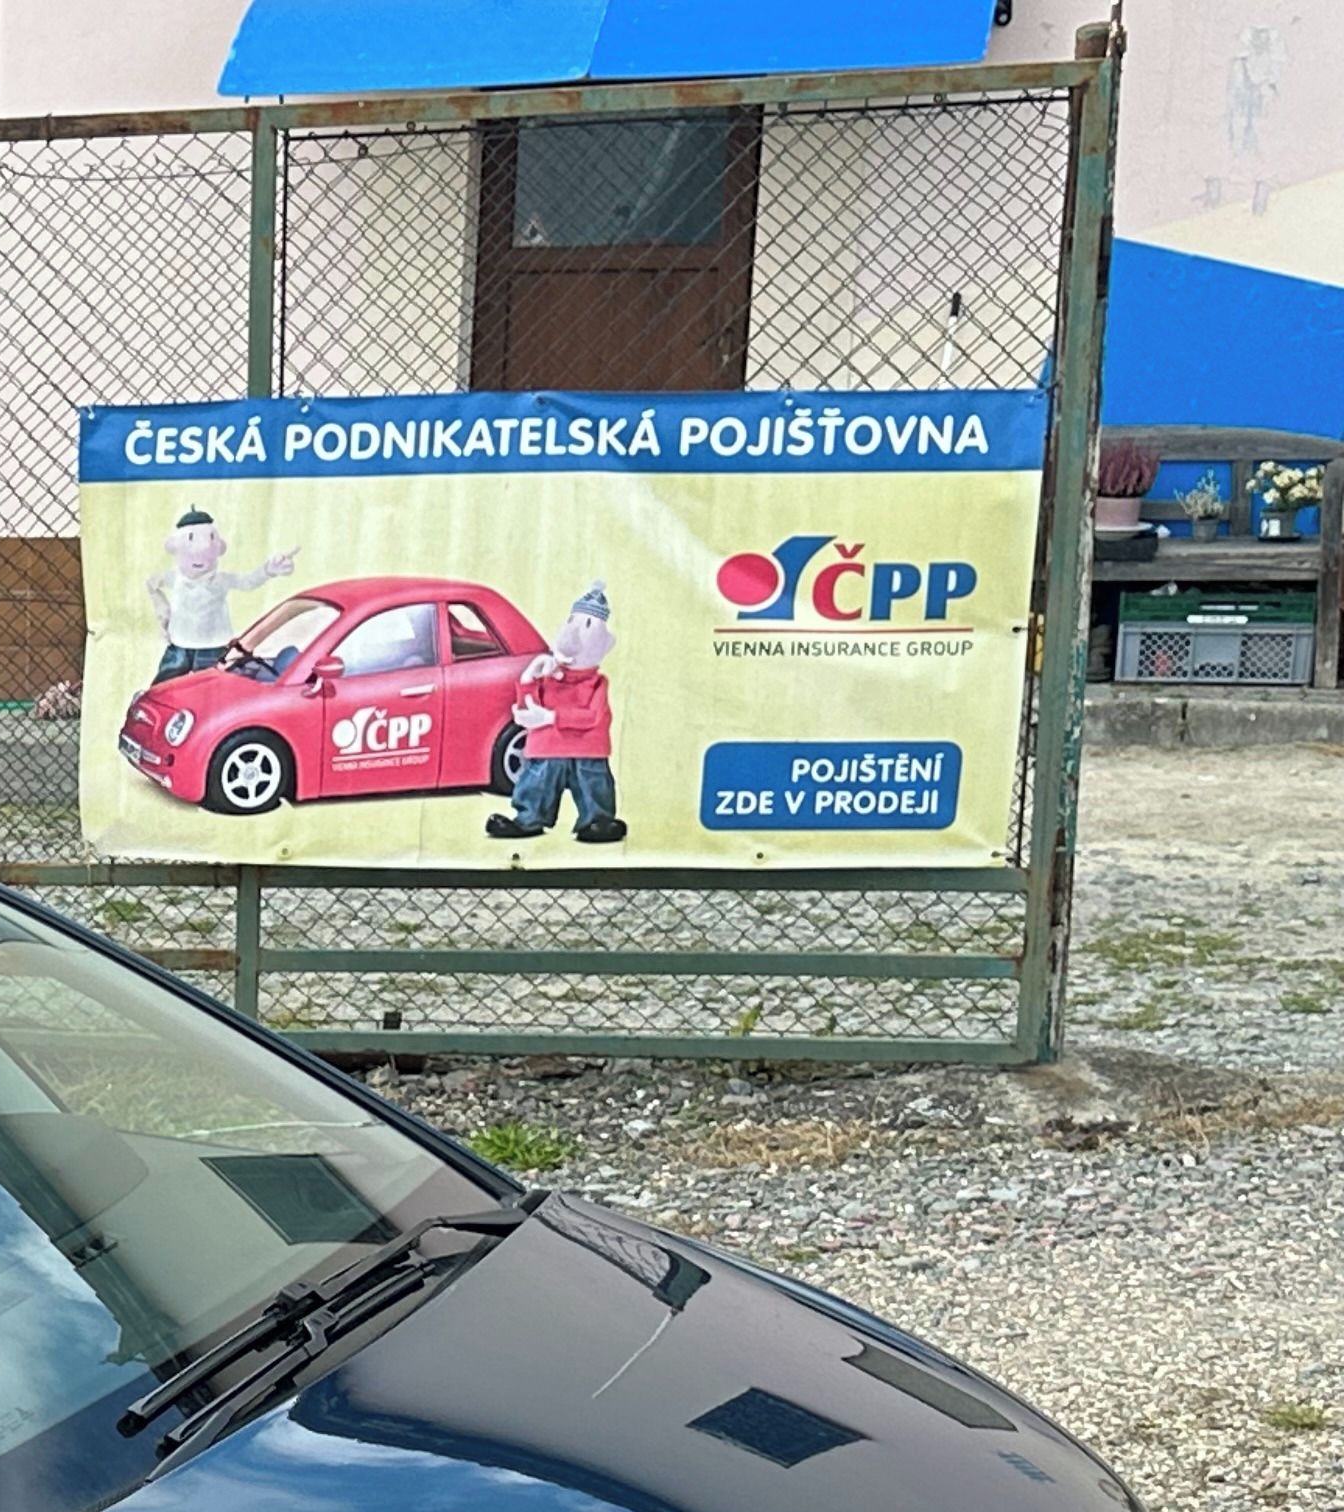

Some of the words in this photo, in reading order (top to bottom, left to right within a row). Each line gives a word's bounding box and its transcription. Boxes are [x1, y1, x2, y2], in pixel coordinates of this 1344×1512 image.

[124, 415, 267, 465] ČESKÁ
[284, 414, 660, 462] PODNIKATELSKÁ
[679, 407, 989, 457] POJIŠŤOVNA
[812, 543, 977, 621] ČPP
[713, 641, 785, 657] VIENNA
[791, 641, 901, 657] INSURANCE
[906, 640, 974, 656] GROUP
[366, 709, 432, 751] ČPP
[791, 752, 944, 783] POJIŠTĚNÍ
[715, 790, 775, 815] ZDE
[784, 790, 806, 815] V
[815, 789, 939, 815] PRODEJI
